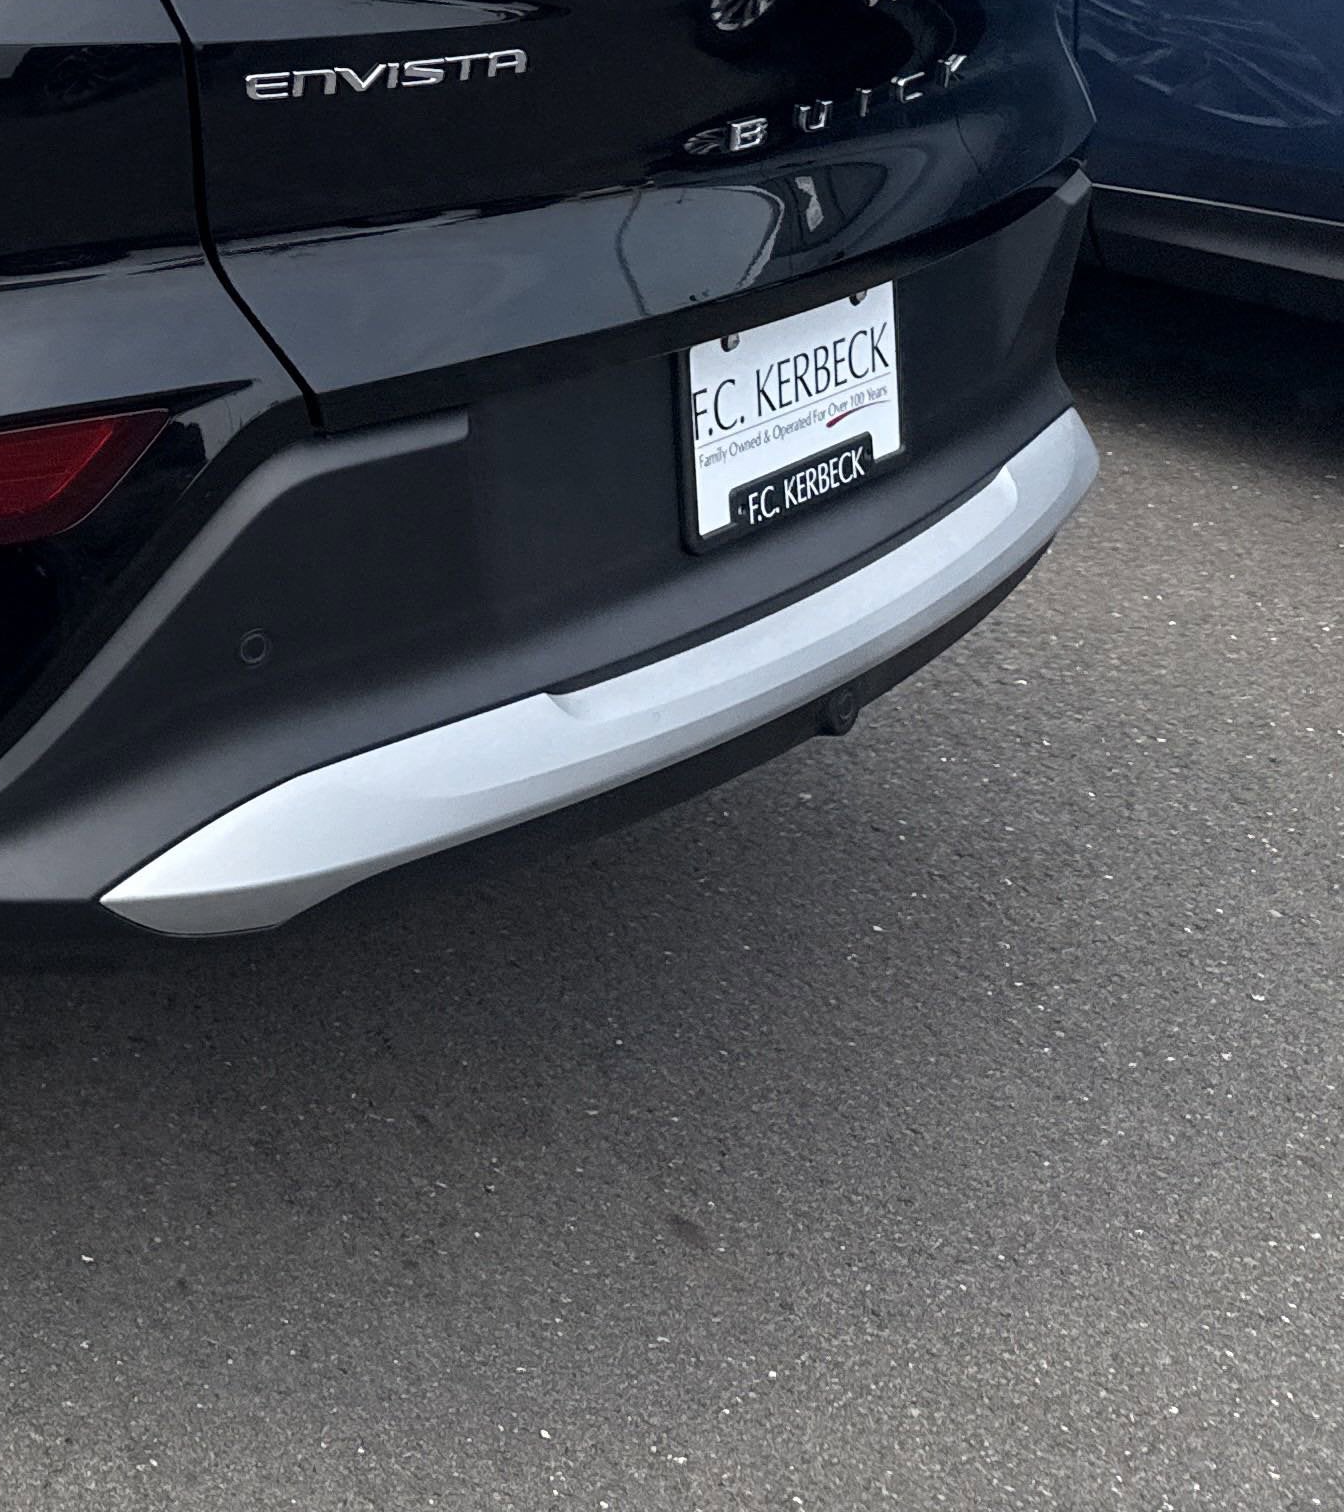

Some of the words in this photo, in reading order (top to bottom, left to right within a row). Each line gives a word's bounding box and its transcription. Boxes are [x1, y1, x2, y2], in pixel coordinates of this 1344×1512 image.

[245, 48, 528, 100] ENVISTA
[728, 54, 968, 152] BUICK
[692, 379, 745, 440] F.C.
[755, 322, 889, 418] KERBECK
[699, 445, 728, 467] Family
[728, 435, 762, 457] Owned
[763, 429, 771, 444] &
[772, 409, 812, 441] Operated
[813, 411, 827, 423] For
[828, 399, 848, 417] Over
[850, 393, 865, 408] 100
[866, 385, 889, 401] Years
[748, 486, 780, 525] F.C.
[784, 446, 865, 509] KERBECK
